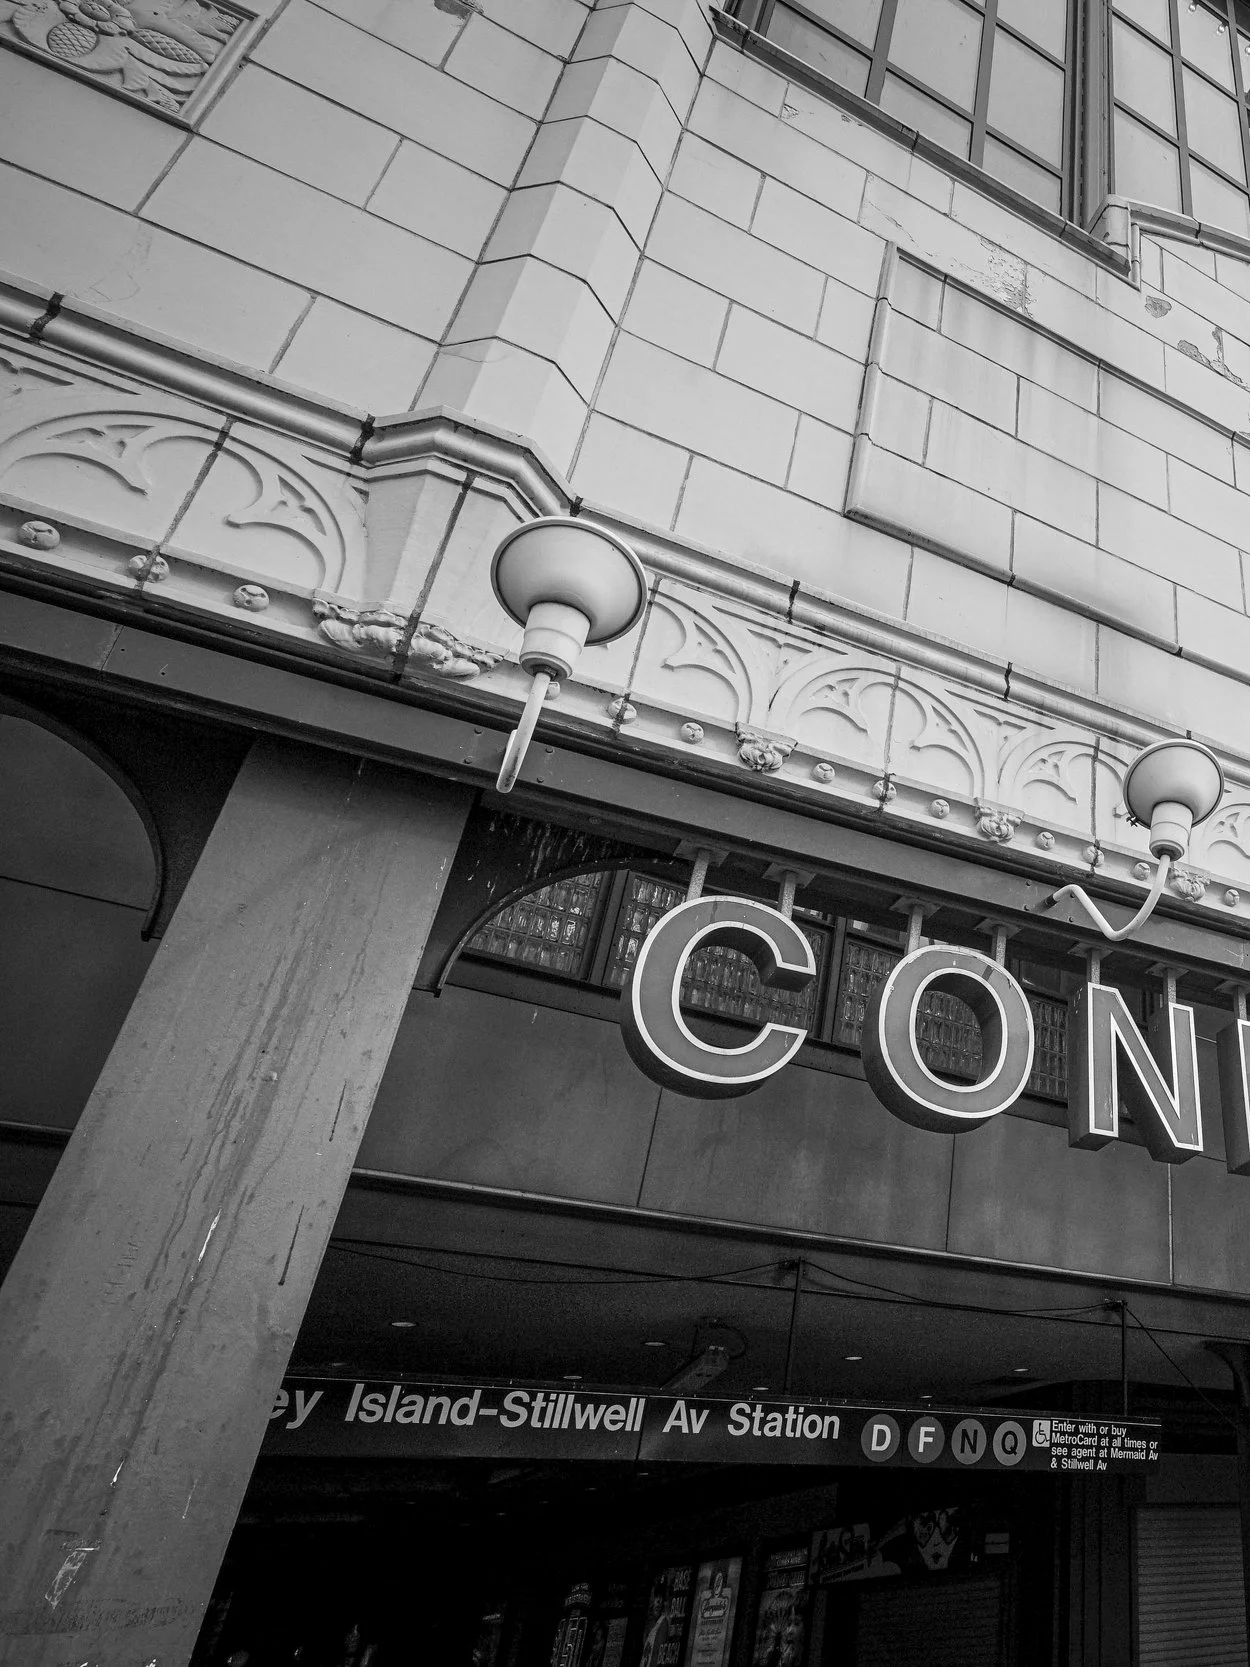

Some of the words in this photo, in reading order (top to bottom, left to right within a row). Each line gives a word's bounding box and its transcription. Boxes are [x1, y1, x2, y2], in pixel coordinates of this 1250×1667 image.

[344, 1383, 647, 1432] Island-Stillwell
[662, 1400, 709, 1434] Av
[727, 1402, 840, 1440] Station
[871, 1424, 892, 1452] D
[917, 1426, 936, 1453] F
[960, 1428, 978, 1455] N
[1001, 1430, 1019, 1456] Q
[1052, 1420, 1076, 1433] Enter
[1079, 1423, 1097, 1434] with
[1099, 1426, 1109, 1435] or
[1111, 1425, 1127, 1437] buy
[1051, 1432, 1098, 1446] MetroCard
[1100, 1436, 1109, 1447] at
[1112, 1437, 1122, 1448] all
[1124, 1437, 1147, 1449] times
[1149, 1441, 1158, 1450] or
[1051, 1446, 1068, 1456] see
[1071, 1447, 1096, 1459] agent
[1099, 1448, 1108, 1458] at
[1110, 1447, 1146, 1460] Mermaid
[1148, 1450, 1159, 1461] Av
[1050, 1457, 1058, 1469] &
[1060, 1457, 1094, 1471] Stillwell
[1096, 1460, 1108, 1471] Av
